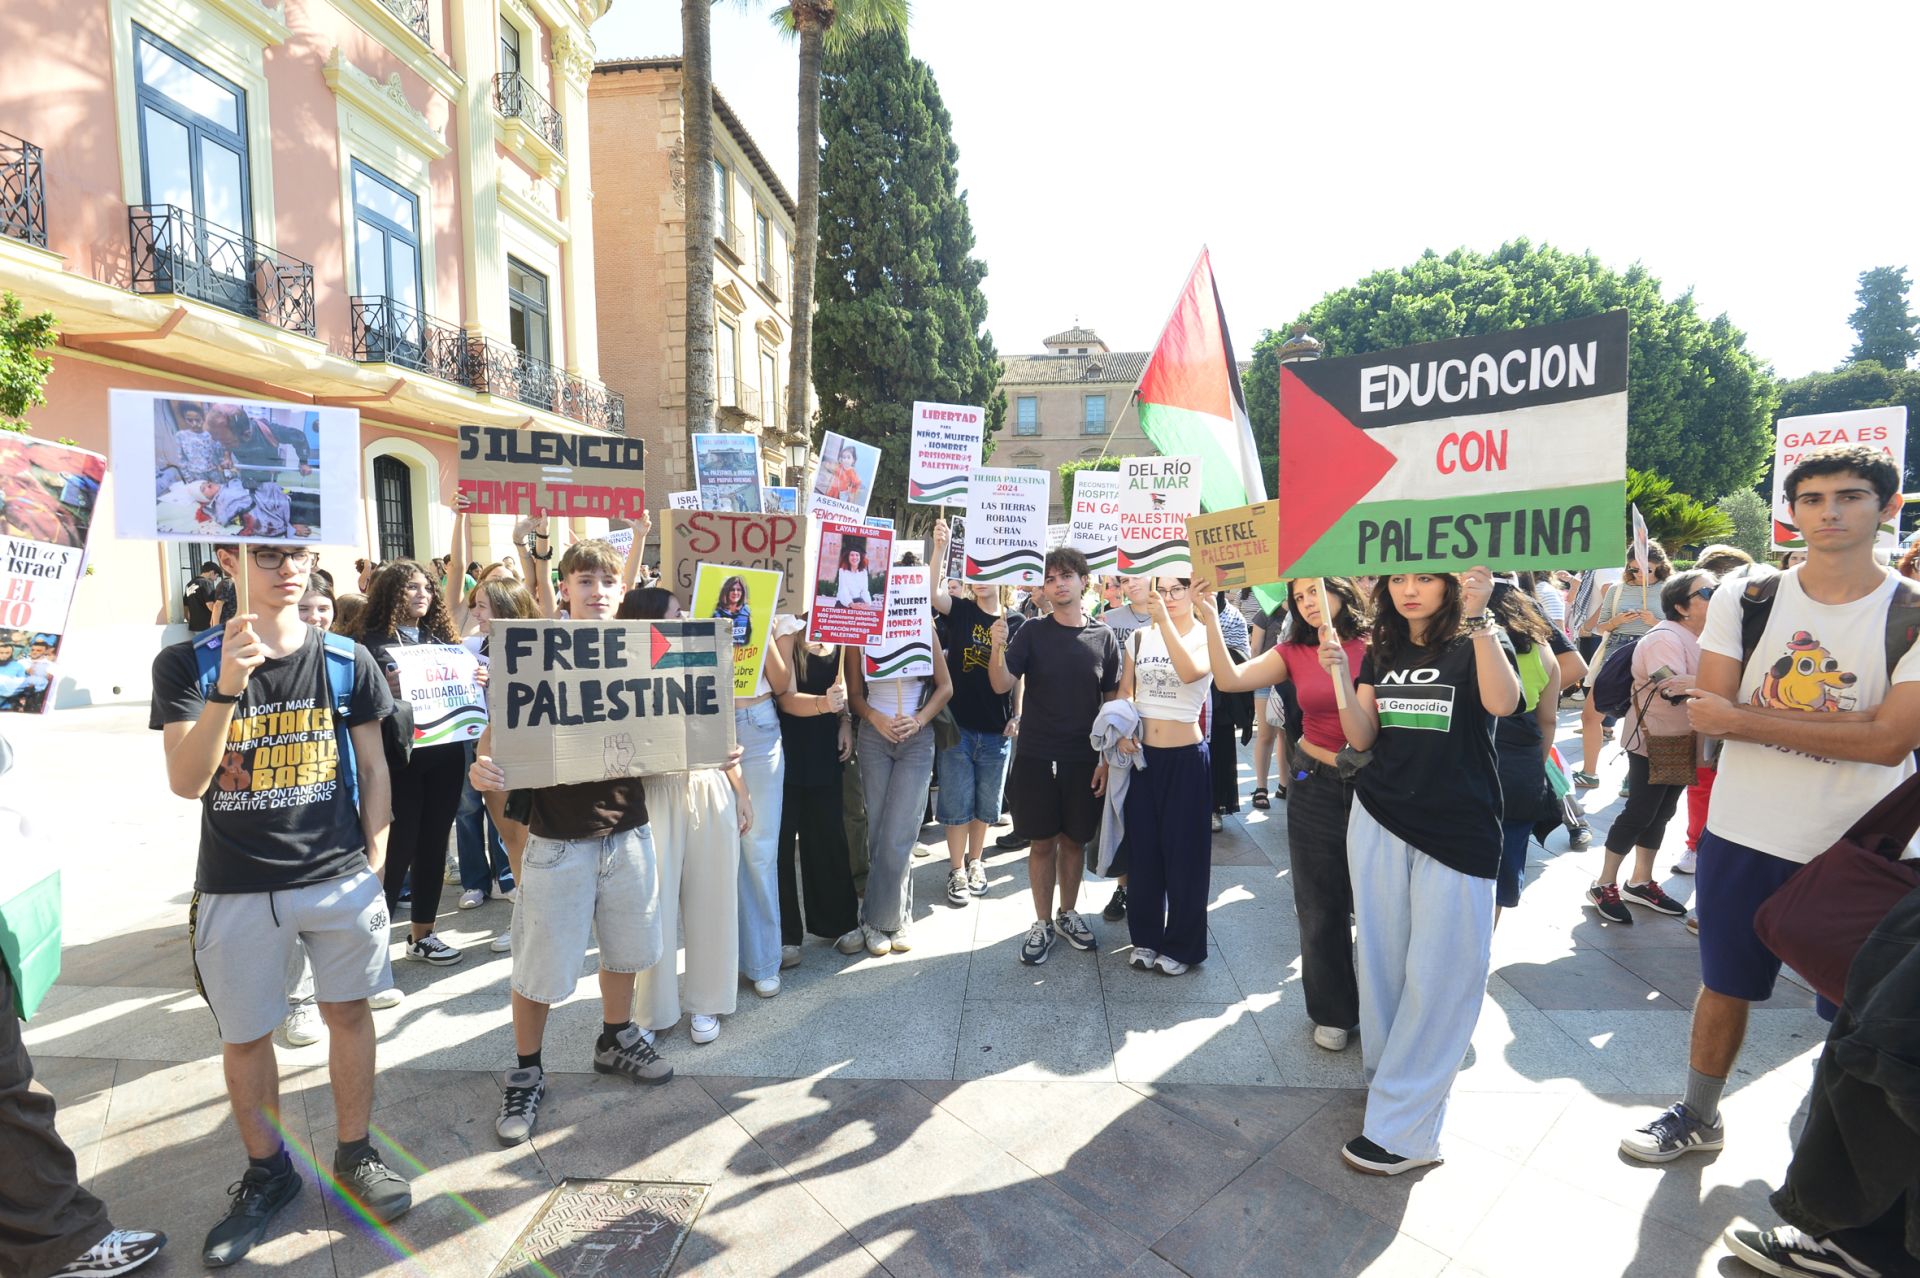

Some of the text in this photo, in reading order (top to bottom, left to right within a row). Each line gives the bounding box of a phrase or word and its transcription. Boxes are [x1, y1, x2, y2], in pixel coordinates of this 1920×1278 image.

[1360, 340, 1598, 413] EDUCACION
[922, 409, 977, 424] LIBERTAD
[944, 433, 980, 443] MUJERES
[1783, 426, 1888, 448] GAZA ES
[460, 425, 644, 470] SILENCIO
[928, 441, 967, 451] HOMBRES
[1436, 429, 1509, 475] CON
[1129, 459, 1191, 477] DEL RÍO
[974, 474, 1046, 485] TIERRA PALESTINA
[997, 484, 1018, 492] 2024
[1128, 476, 1189, 490] AL MAR
[458, 479, 645, 519] COMPLICIDAD
[677, 495, 698, 505] ISRA
[816, 496, 860, 513] ASESINADA
[981, 502, 1036, 512] LAS TIERRAS
[1076, 502, 1095, 513] EN
[986, 513, 1027, 523] ROBADAS
[1073, 521, 1119, 531] QUE PAG
[688, 511, 797, 558] STOP
[1074, 532, 1105, 541] ISRAEL
[1121, 527, 1189, 540] VENCER
[1195, 520, 1257, 546] FREE FREE
[1358, 505, 1591, 564] PALESTINA
[975, 537, 1038, 547] RECUPERADAS
[1200, 539, 1269, 565] PALESTINE
[7, 557, 62, 580] Israel
[5, 577, 35, 602] EL
[894, 597, 928, 605] MUJERES
[505, 627, 628, 675] FREE
[426, 667, 459, 682] GAZA
[1380, 668, 1440, 685] NO
[411, 684, 476, 701] SOLIDARIDAD
[243, 698, 316, 717] I DON'T MAKE
[507, 674, 719, 729] PALESTINE
[1389, 700, 1448, 713] Genocidio
[224, 730, 334, 752] WHEN PLAYING THE
[253, 740, 338, 769] DOUBLE
[251, 760, 337, 791] BASS
[213, 781, 337, 801] I MAKE SPONTANEOUS
[213, 791, 332, 811] CREATIVE DECISIONS
